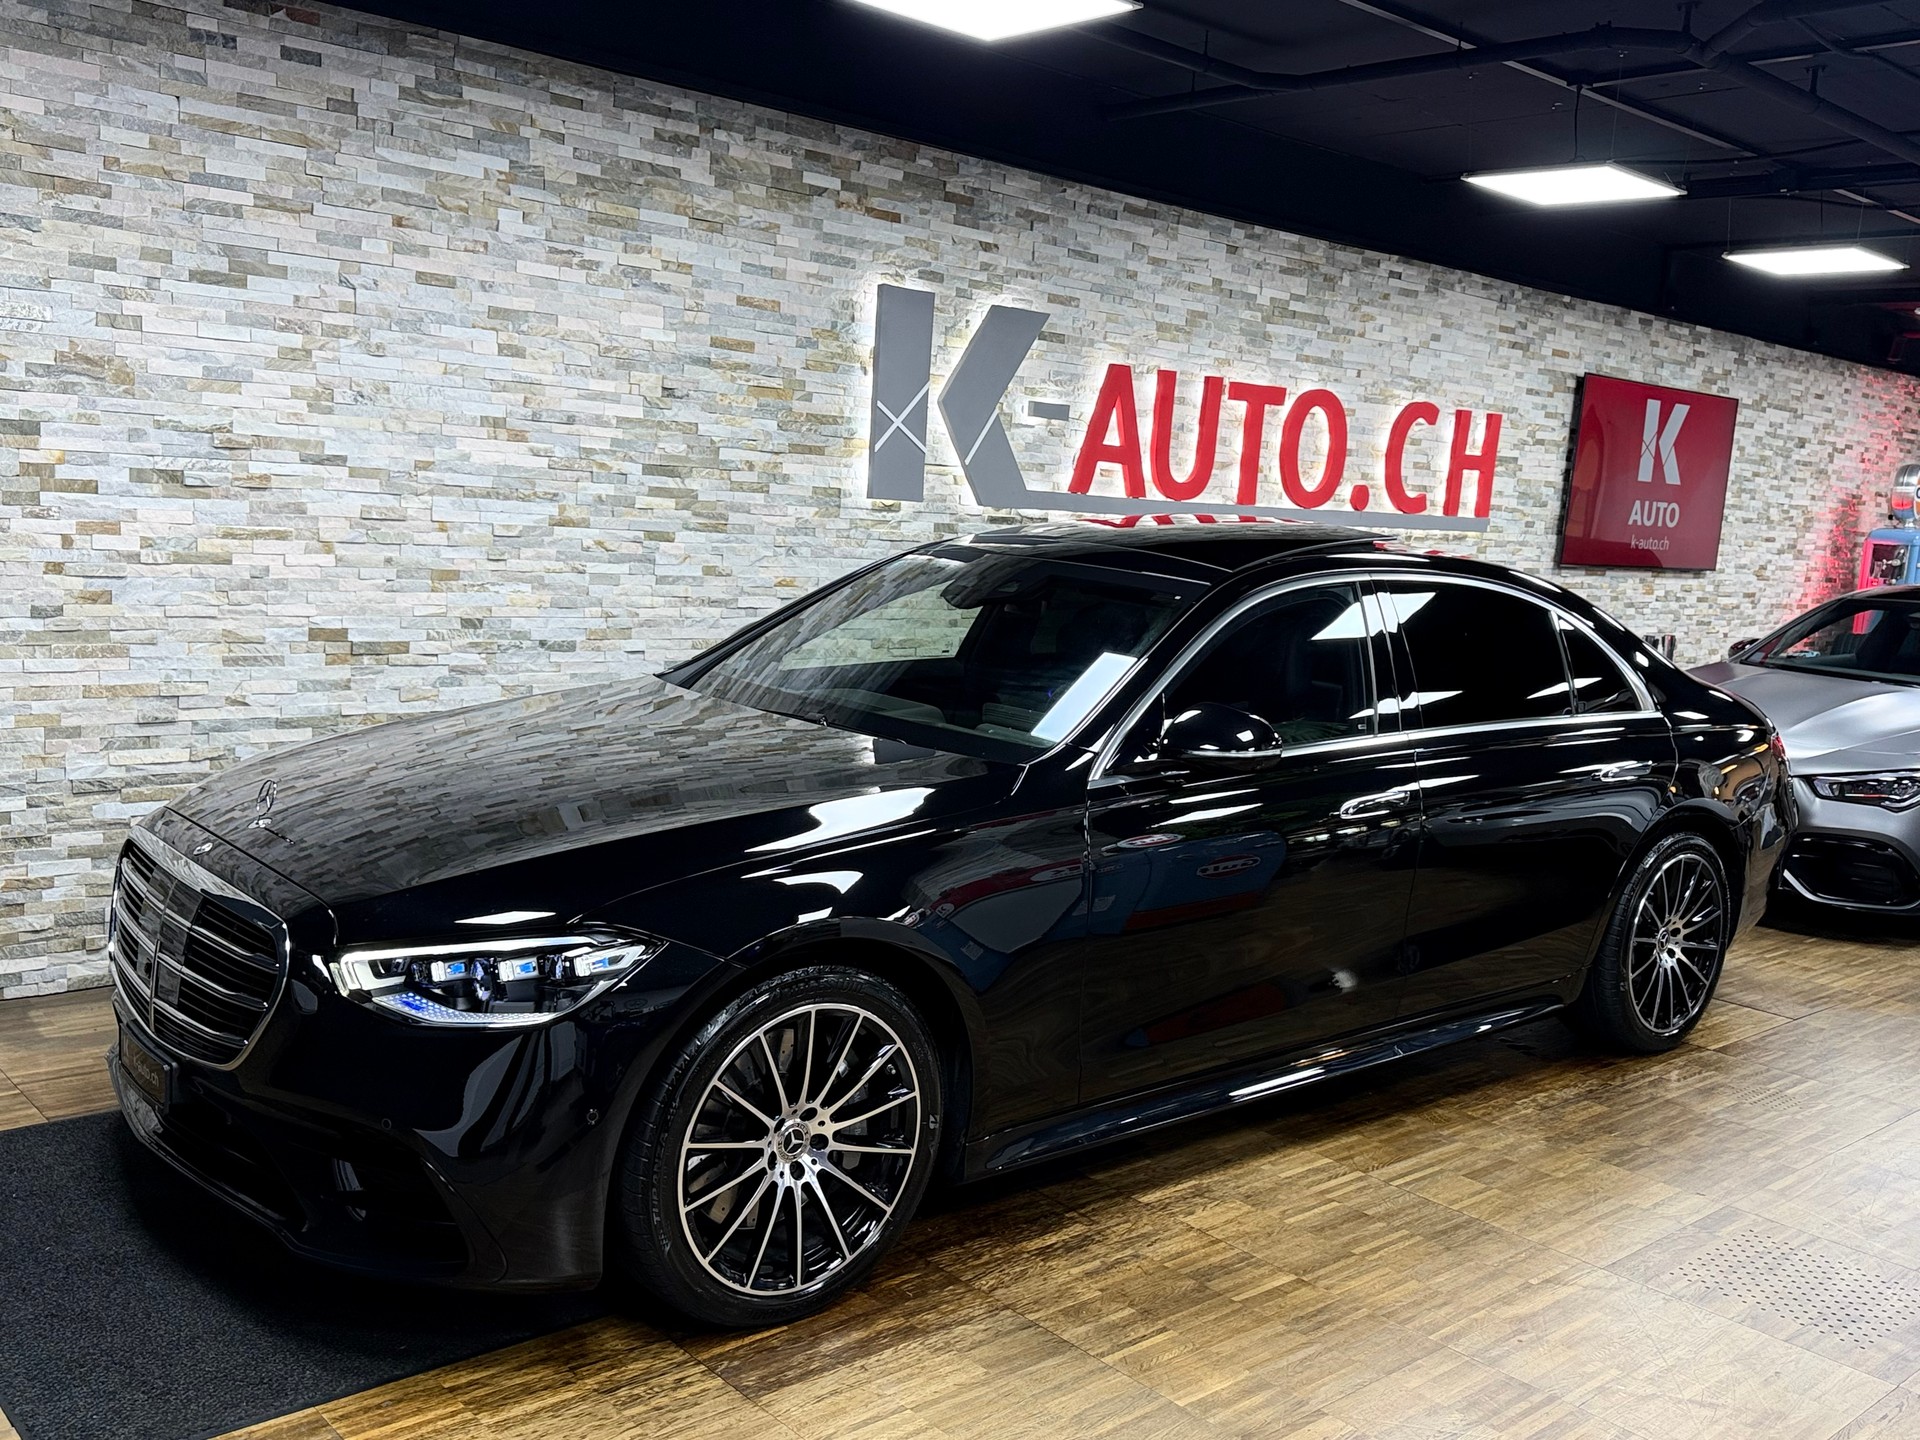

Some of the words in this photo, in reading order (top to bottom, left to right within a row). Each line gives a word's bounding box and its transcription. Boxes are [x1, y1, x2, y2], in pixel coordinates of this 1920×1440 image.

[867, 283, 1502, 518] K-AUTO.CH
[1638, 399, 1690, 485] K
[1627, 500, 1680, 528] AUTO
[1631, 535, 1670, 550] k-auto.ch
